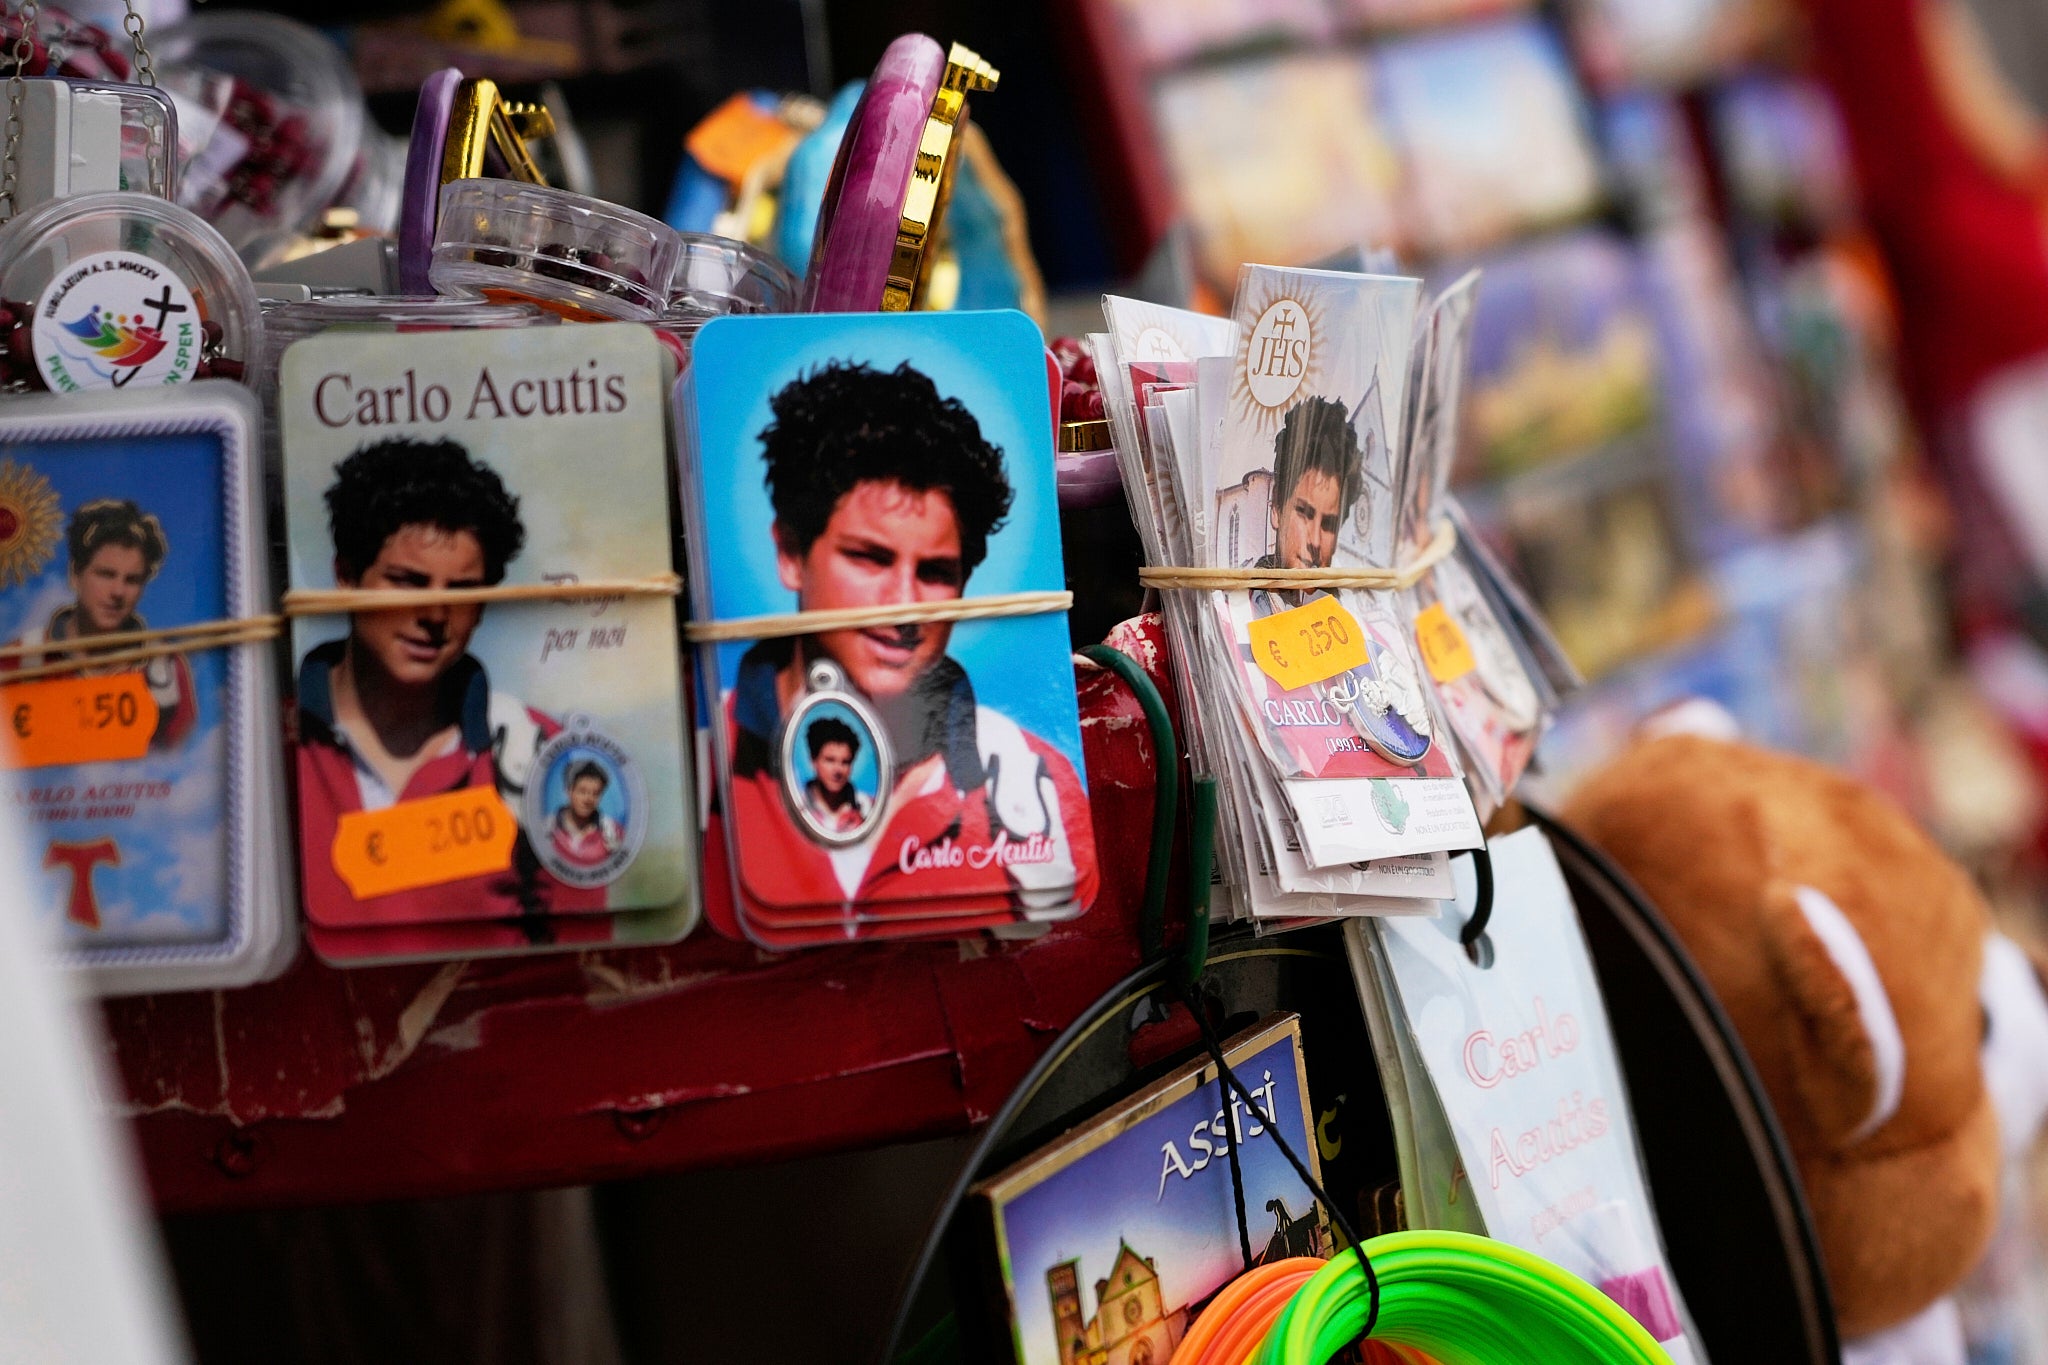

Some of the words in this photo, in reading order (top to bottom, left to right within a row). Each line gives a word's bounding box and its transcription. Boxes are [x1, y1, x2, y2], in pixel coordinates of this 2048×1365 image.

[176, 323, 194, 370] SPEM
[312, 368, 451, 428] Carlo
[466, 359, 628, 419] Acutis
[12, 703, 33, 738] €
[1264, 699, 1342, 727] CARLO
[1325, 737, 1370, 756] (1991-2
[898, 834, 965, 876] Carlo
[966, 829, 1056, 871] Acutis
[1463, 996, 1580, 1090] Carlo
[1490, 1090, 1611, 1191] Acutis
